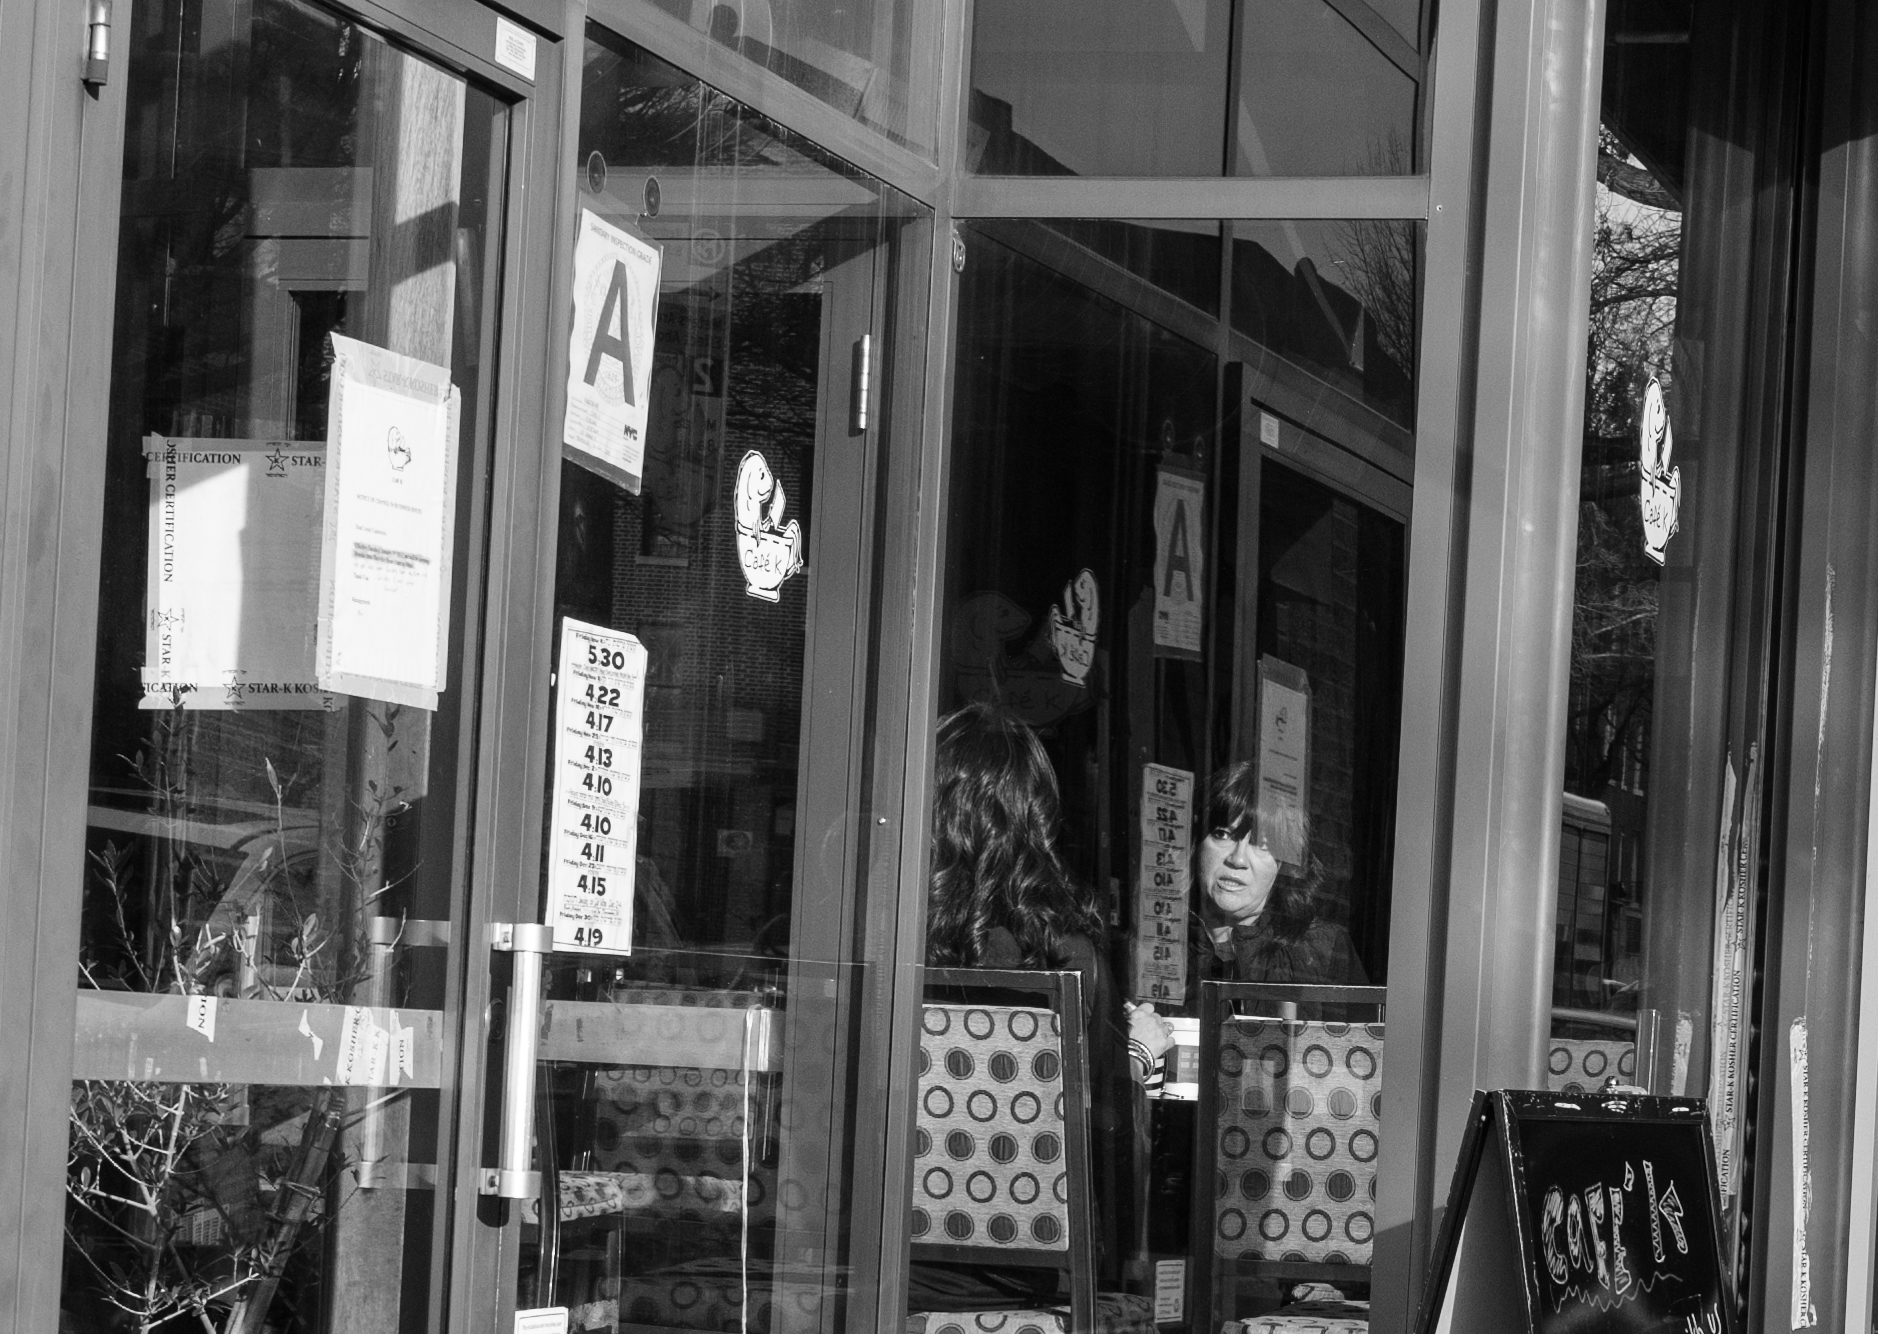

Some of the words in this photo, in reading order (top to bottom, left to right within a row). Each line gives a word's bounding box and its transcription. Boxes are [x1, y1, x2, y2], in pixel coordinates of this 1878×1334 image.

[583, 259, 635, 408] A
[291, 455, 326, 467] STAR-
[164, 484, 176, 582] CERTIFICATION
[745, 550, 770, 572] Café
[248, 682, 292, 694] STAR-K
[1730, 970, 1741, 1041] CERTIFICATION
[1728, 1042, 1737, 1079] KOSHER
[1726, 1081, 1735, 1113] STAR-K
[1643, 1160, 1688, 1263] K
